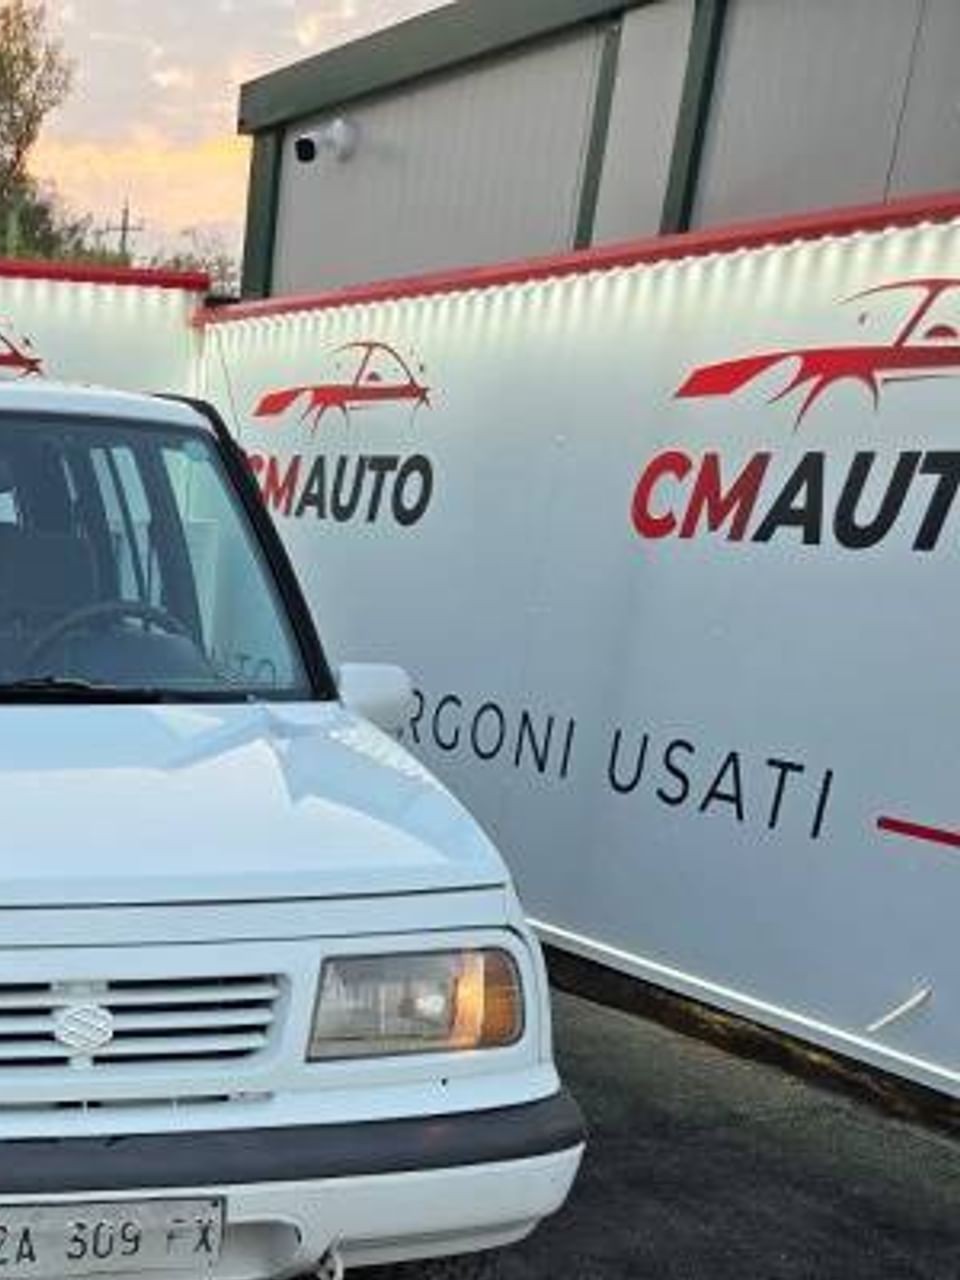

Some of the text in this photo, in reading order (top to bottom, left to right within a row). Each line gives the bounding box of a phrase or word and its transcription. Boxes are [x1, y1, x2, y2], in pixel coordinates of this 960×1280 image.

[630, 449, 960, 551] CMAUT
[607, 729, 834, 839] USATI
[66, 1221, 141, 1260] 309
